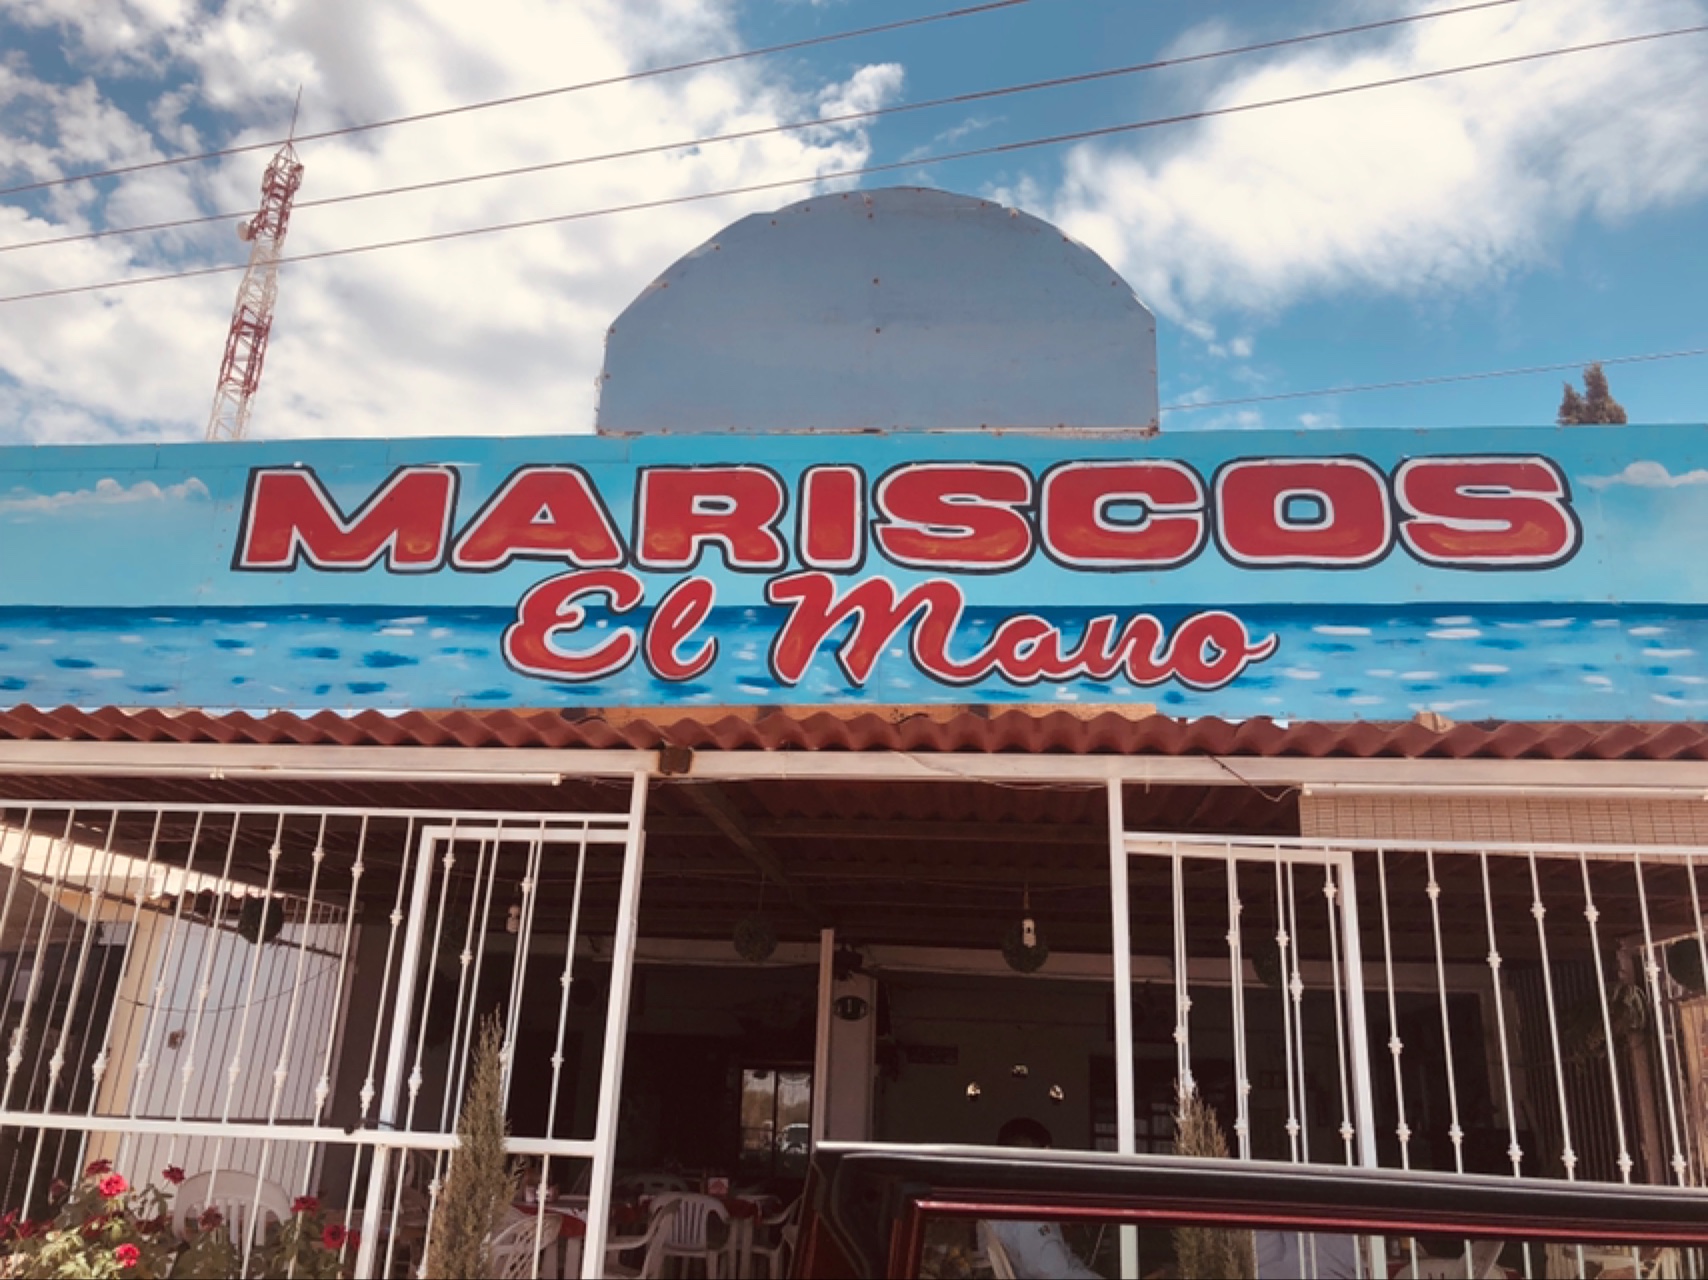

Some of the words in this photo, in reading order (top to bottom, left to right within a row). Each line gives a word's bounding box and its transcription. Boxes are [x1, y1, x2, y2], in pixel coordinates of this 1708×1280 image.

[232, 454, 1583, 573] MARISCOS
[501, 568, 718, 683] El
[765, 569, 1279, 691] Mano
